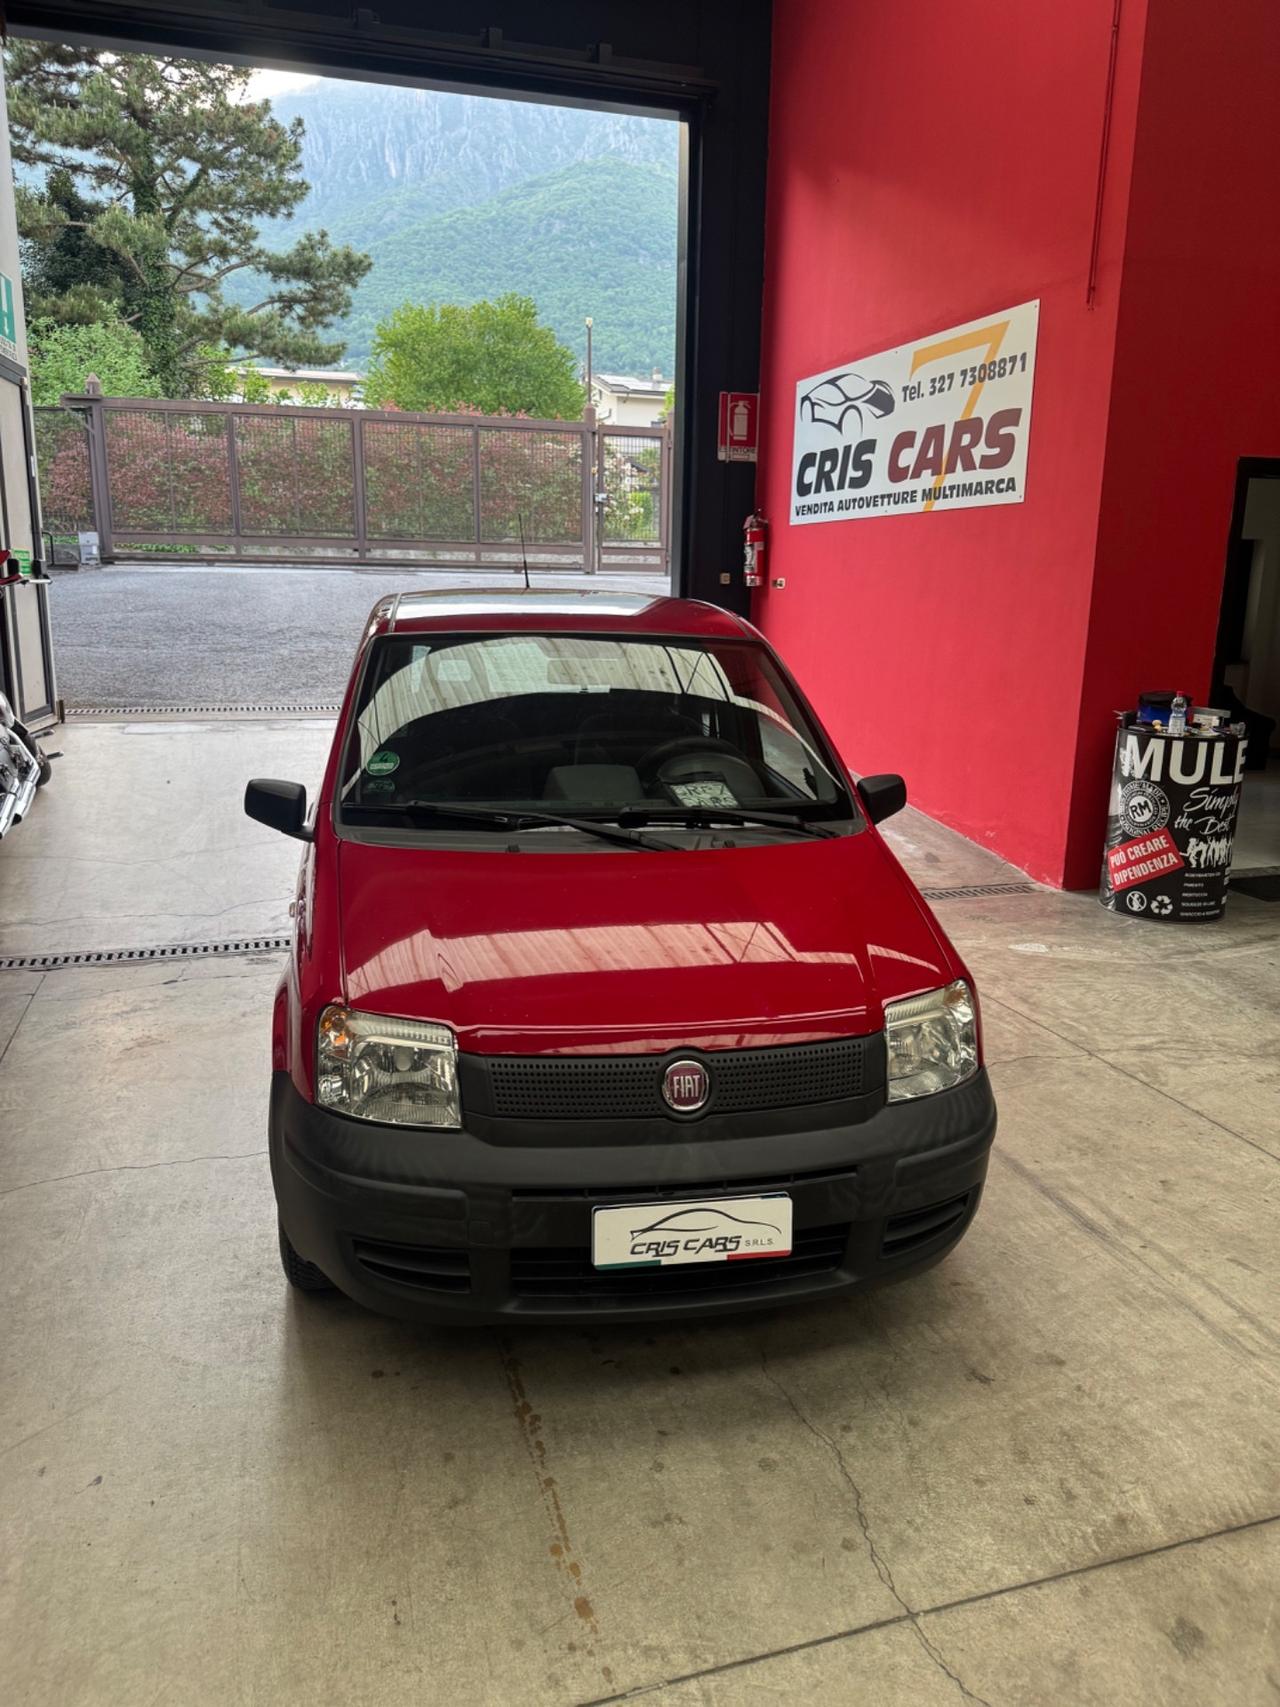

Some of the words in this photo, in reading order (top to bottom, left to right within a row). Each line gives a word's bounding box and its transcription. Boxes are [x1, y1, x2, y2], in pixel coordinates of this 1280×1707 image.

[902, 381, 925, 403] Tel.
[929, 372, 955, 396] 327
[960, 352, 1027, 388] 7308871
[795, 438, 877, 497] CRIS
[887, 407, 1023, 484] CARS
[795, 500, 834, 517] VENDITA
[837, 490, 918, 512] AUTOVETTURE
[921, 477, 1017, 502] MULTIMARCA
[1129, 799, 1152, 819] RM
[1194, 814, 1236, 836] Best
[1128, 834, 1170, 861] CREARE
[1114, 852, 1179, 885] DIPENDENZA
[673, 1074, 701, 1099] FIAT
[630, 1240, 681, 1258] CRIS
[683, 1235, 742, 1255] CARS
